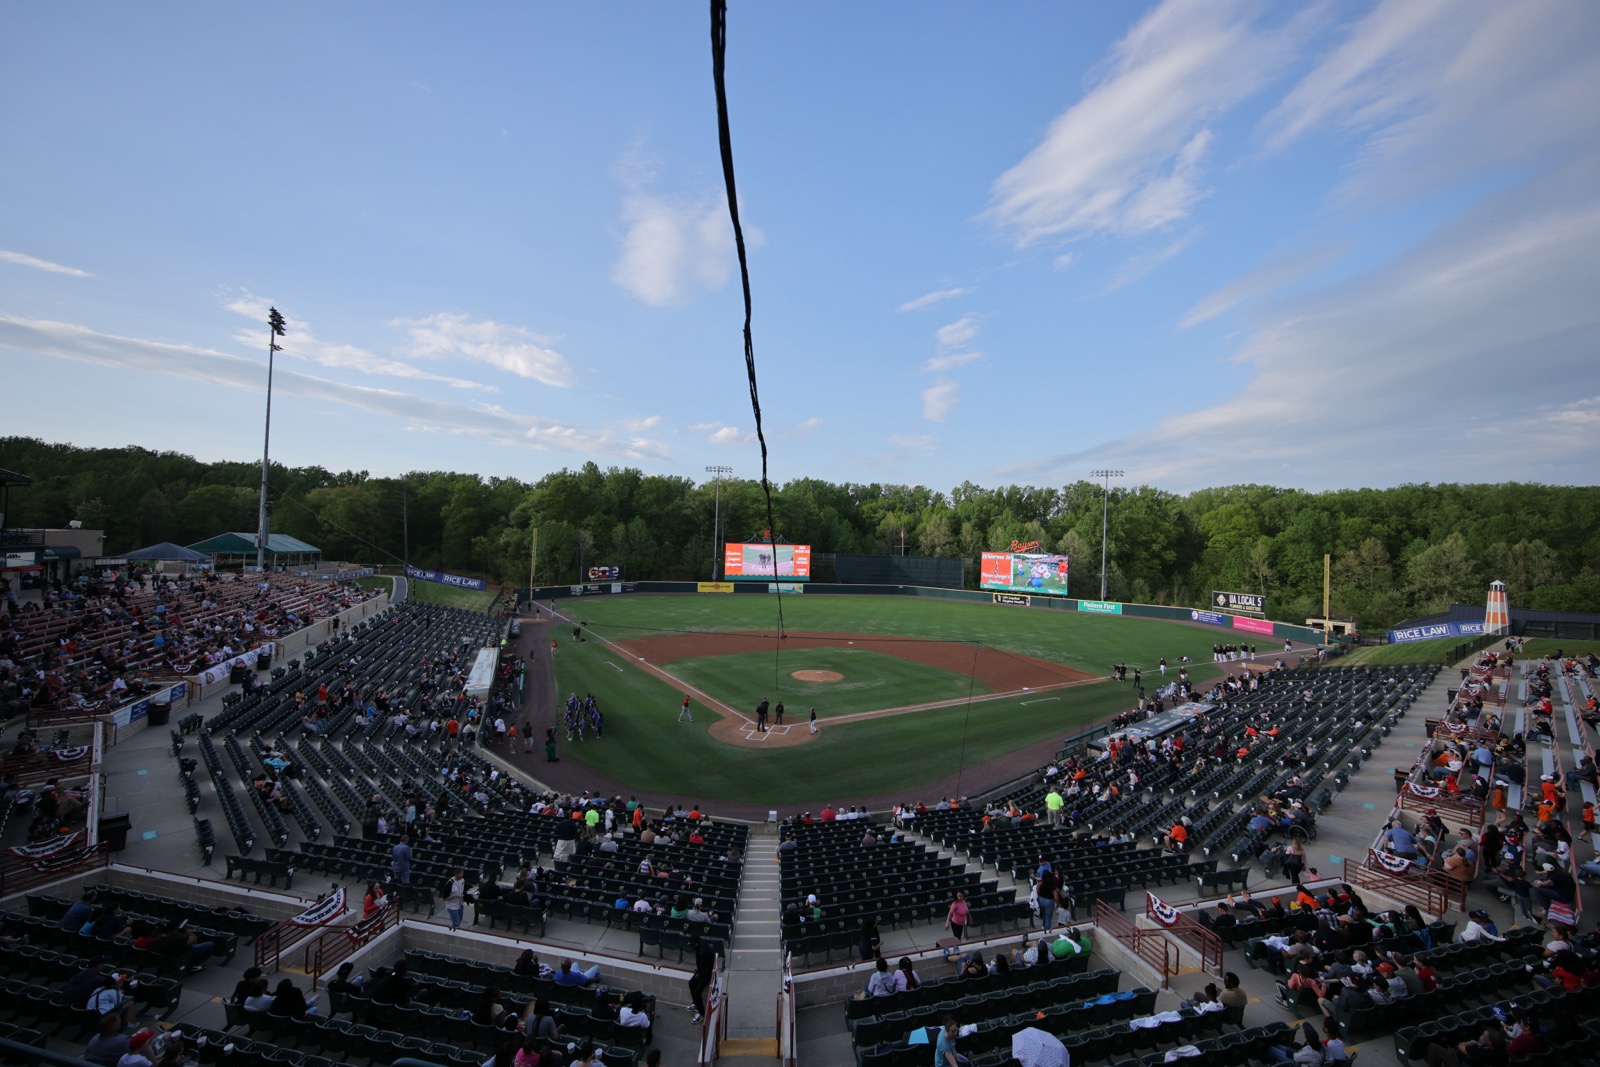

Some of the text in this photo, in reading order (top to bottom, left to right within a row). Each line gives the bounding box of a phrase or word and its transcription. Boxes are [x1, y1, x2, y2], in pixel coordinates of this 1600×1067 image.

[1010, 540, 1040, 553] Baysox
[443, 575, 479, 587] RICE LAW
[1083, 601, 1103, 609] Patient
[1229, 595, 1237, 604] UA
[1237, 596, 1256, 606] LOCAL
[1396, 626, 1446, 640] RICE LAW
[1462, 624, 1481, 632] RICE
